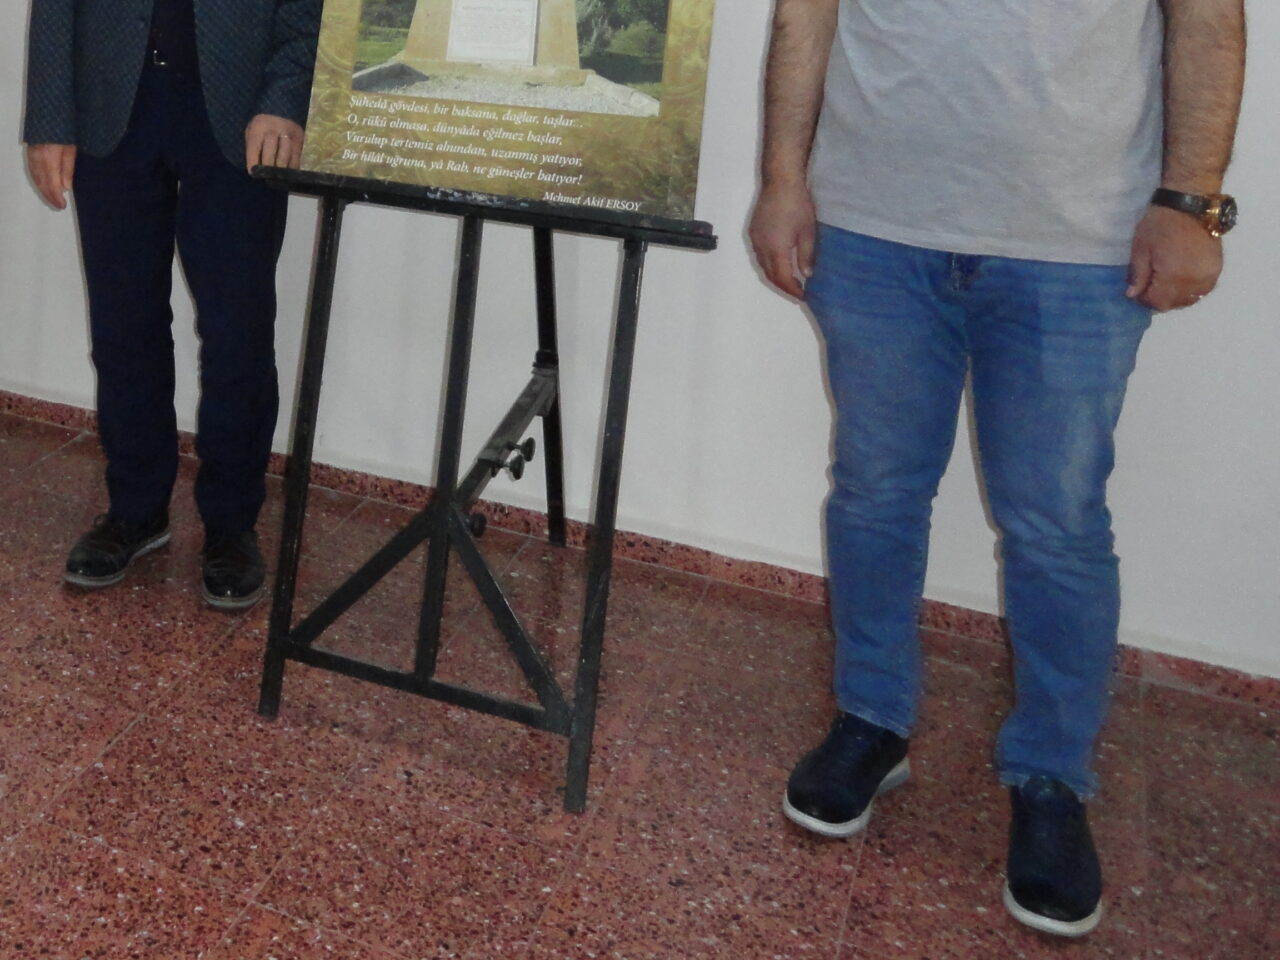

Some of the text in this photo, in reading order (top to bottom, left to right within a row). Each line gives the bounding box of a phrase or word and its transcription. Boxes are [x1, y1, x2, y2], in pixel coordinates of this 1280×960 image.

[347, 112, 360, 126] O,
[389, 118, 430, 132] olmasa,
[483, 127, 525, 142] eğilmez
[527, 130, 563, 146] başlar,
[388, 100, 430, 114] gövdesi,
[433, 102, 450, 115] bir
[451, 104, 498, 121] baksana,
[502, 109, 539, 125] dağlar,
[346, 130, 584, 168] Vurulup tertemiz alnından, uzanmış yatıyor,
[342, 148, 359, 161] Bir
[386, 154, 427, 168] uğruna,
[446, 159, 469, 173] Rab,
[472, 164, 487, 175] ne
[486, 165, 536, 181] güneşler
[537, 168, 584, 186] batıyor!
[542, 191, 643, 211] Mehmet Akif ERSOY
